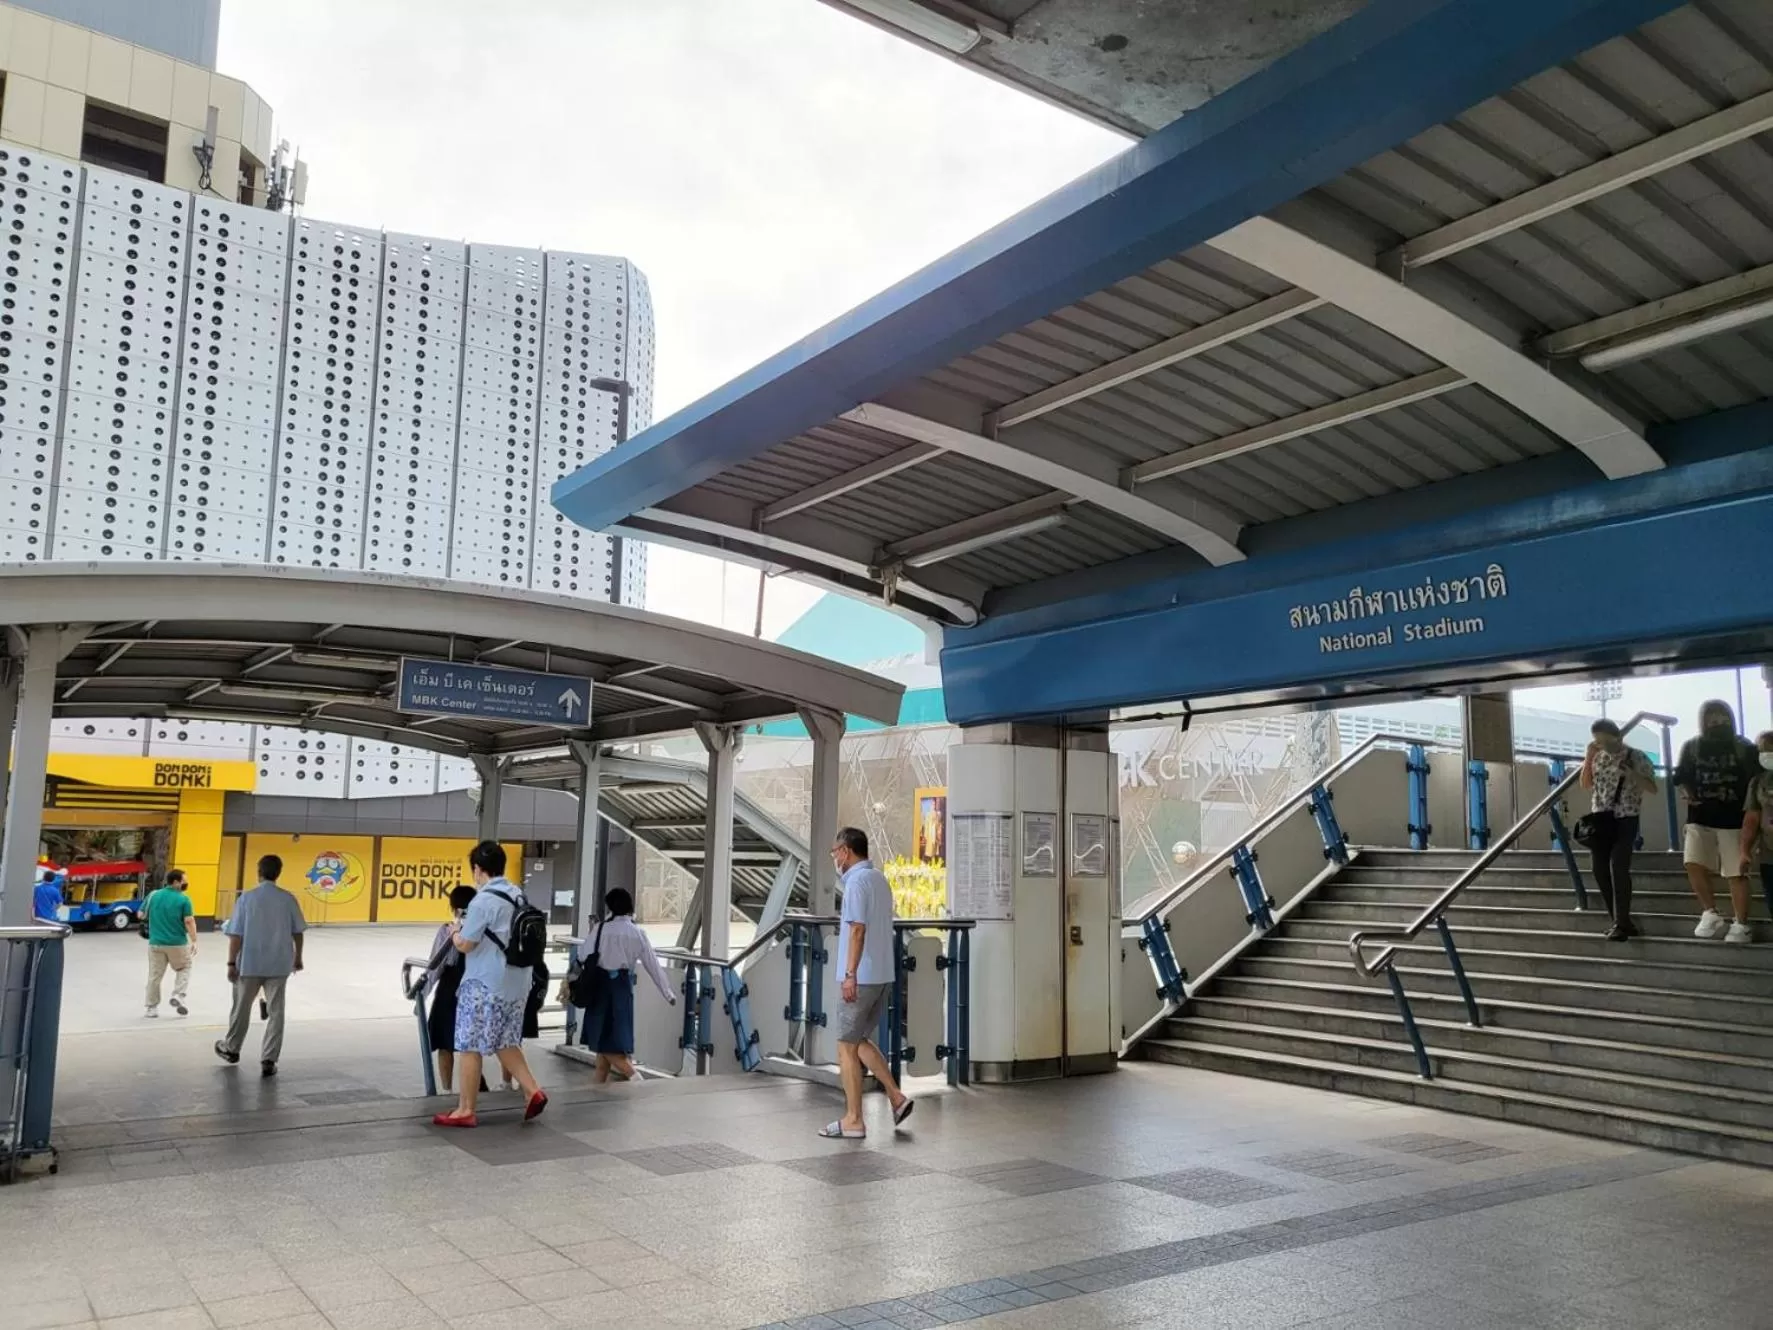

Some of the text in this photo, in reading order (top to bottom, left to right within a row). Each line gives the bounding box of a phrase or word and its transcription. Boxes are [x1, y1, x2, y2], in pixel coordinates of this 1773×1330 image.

[1288, 563, 1508, 629] สนามกีฬาแห่งชาติ
[1319, 616, 1484, 653] National Stadium
[411, 694, 438, 706] MBK
[441, 697, 477, 710] Center
[1159, 750, 1265, 781] CENTER
[154, 772, 211, 788] DONKI
[381, 864, 417, 878] DON
